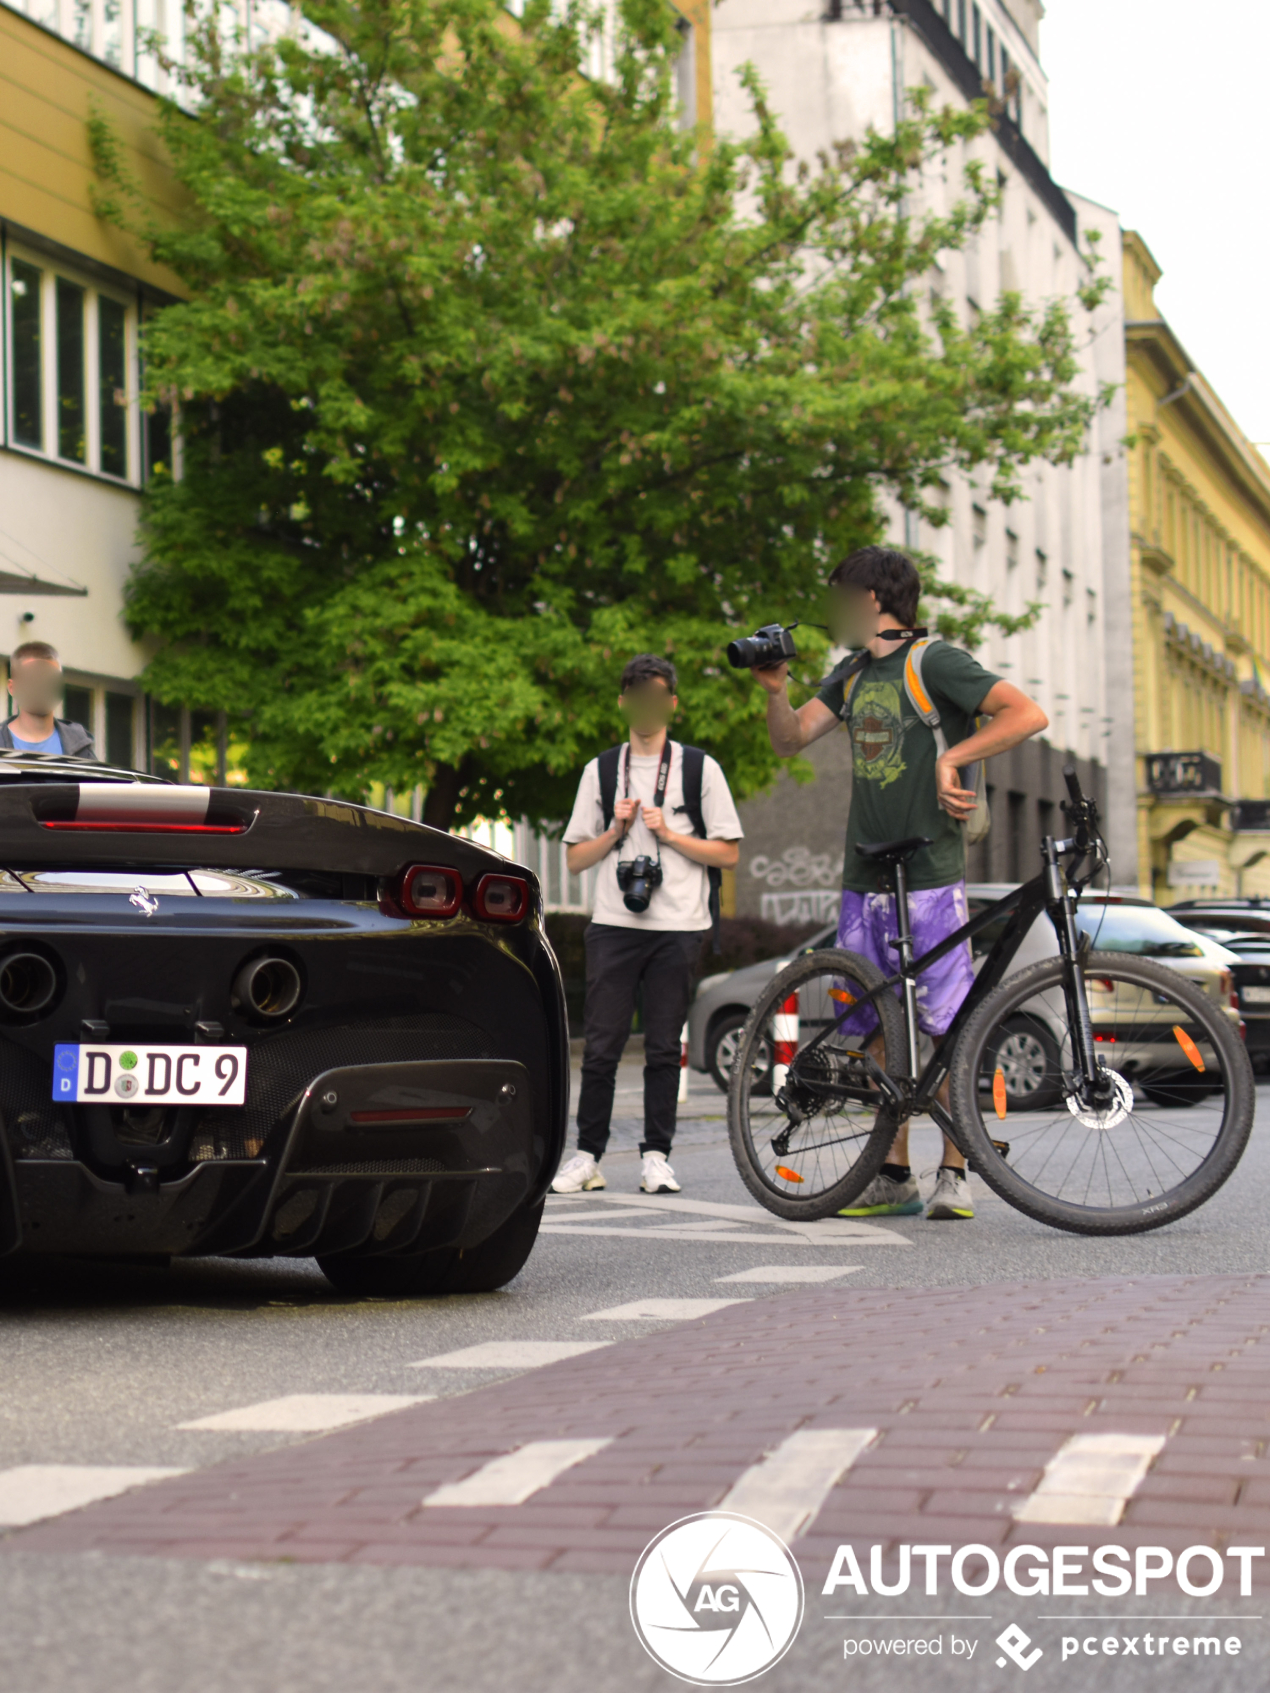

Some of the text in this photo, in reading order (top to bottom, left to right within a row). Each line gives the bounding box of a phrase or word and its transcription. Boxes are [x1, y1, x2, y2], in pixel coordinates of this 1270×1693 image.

[60, 1078, 71, 1092] D
[84, 1052, 239, 1096] D DC 9
